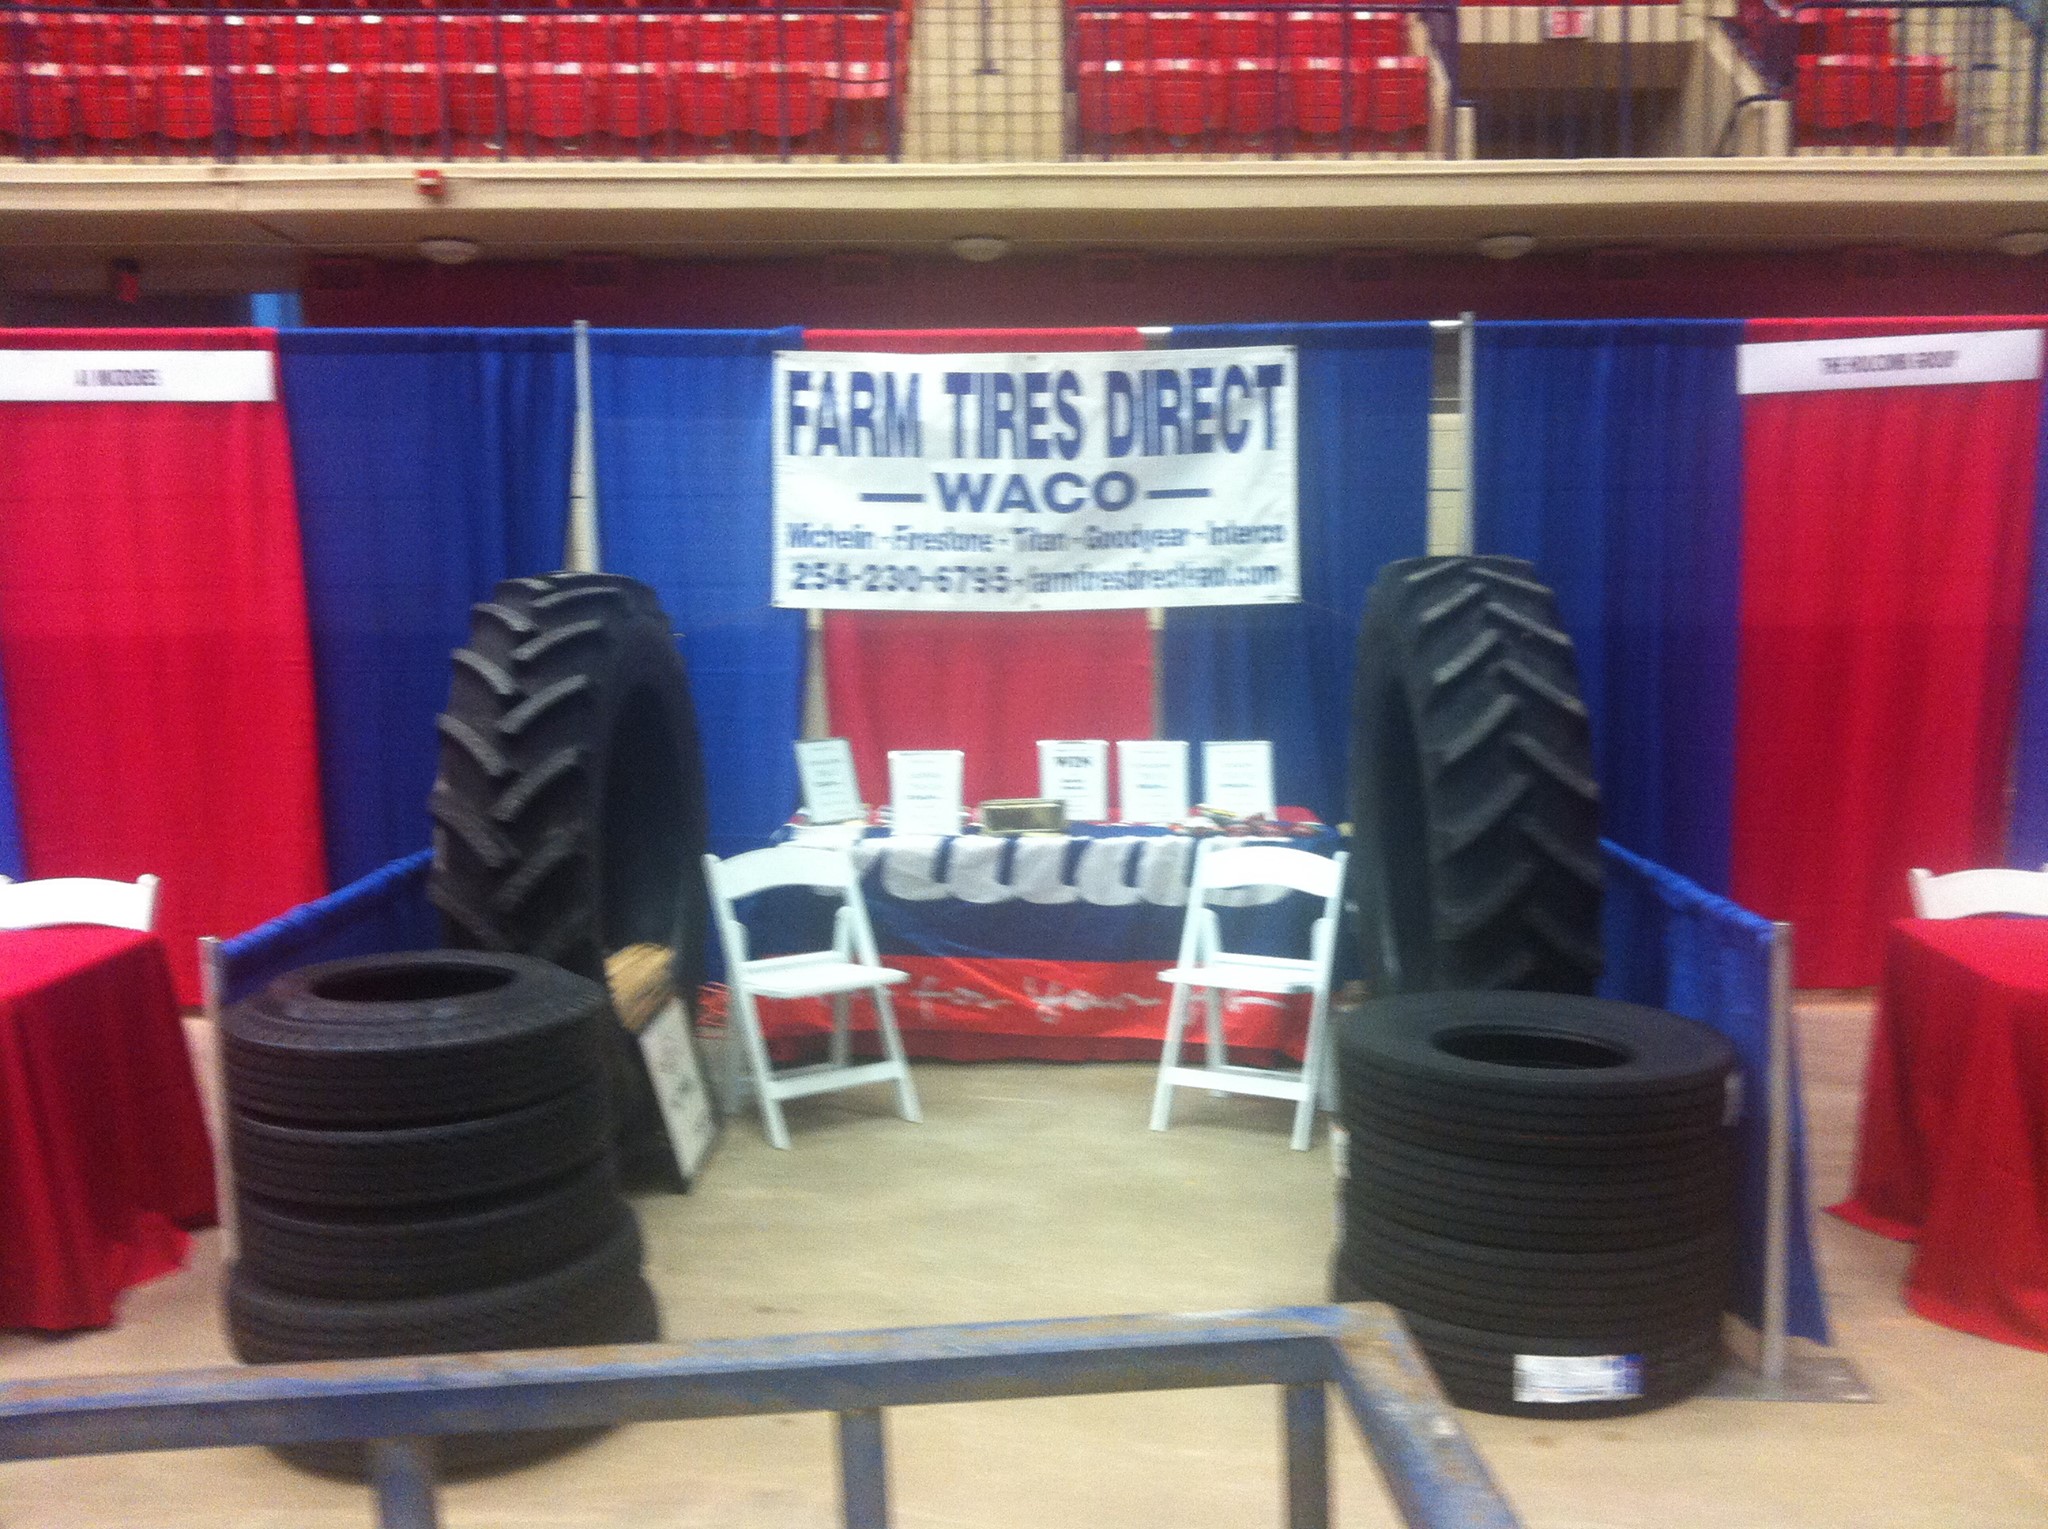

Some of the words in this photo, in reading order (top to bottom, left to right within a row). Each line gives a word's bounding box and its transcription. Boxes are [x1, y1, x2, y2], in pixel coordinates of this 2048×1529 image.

[787, 369, 923, 457] FARM
[944, 369, 1085, 460] TIRES
[1105, 364, 1284, 459] DIRECT
[933, 471, 1138, 514] WACO
[786, 522, 874, 549] Michelin
[892, 525, 994, 551] Firestone
[1085, 523, 1190, 553] Goodyear
